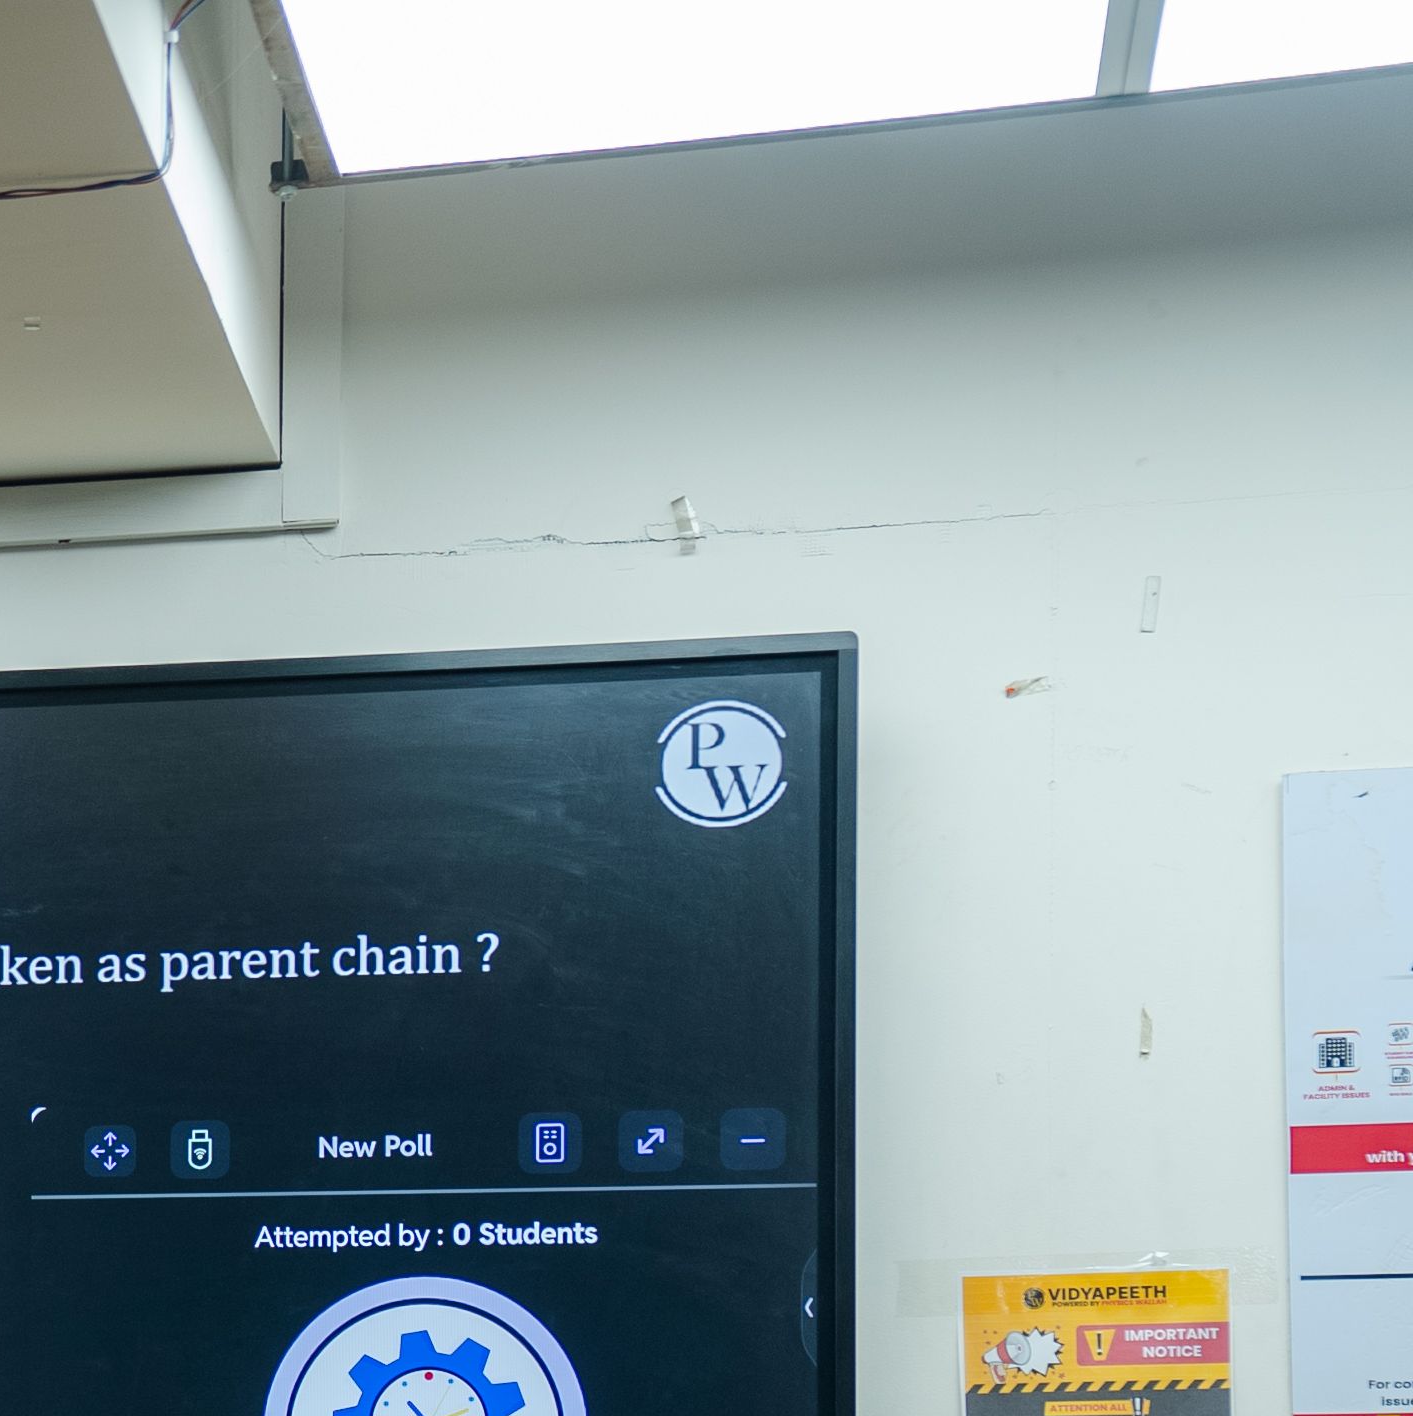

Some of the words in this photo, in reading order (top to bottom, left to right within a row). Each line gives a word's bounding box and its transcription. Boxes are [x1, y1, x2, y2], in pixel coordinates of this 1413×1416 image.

[96, 950, 147, 984] as
[160, 941, 320, 992] parent
[332, 936, 462, 977] chain
[476, 933, 500, 972] ?
[318, 1135, 376, 1160] New
[384, 1132, 433, 1158] Poll
[1365, 1150, 1405, 1163] with
[255, 1224, 391, 1253] Attempted
[398, 1223, 431, 1252] by
[452, 1222, 471, 1246] 0
[478, 1220, 599, 1247] Students
[1049, 1286, 1166, 1301] VIDYAPEETH
[1124, 1328, 1219, 1342] IMPORTANT
[1142, 1345, 1202, 1358] NOTICE
[1368, 1380, 1391, 1390] For
[1050, 1403, 1108, 1413] ATTENTION
[1110, 1403, 1127, 1412] ALL
